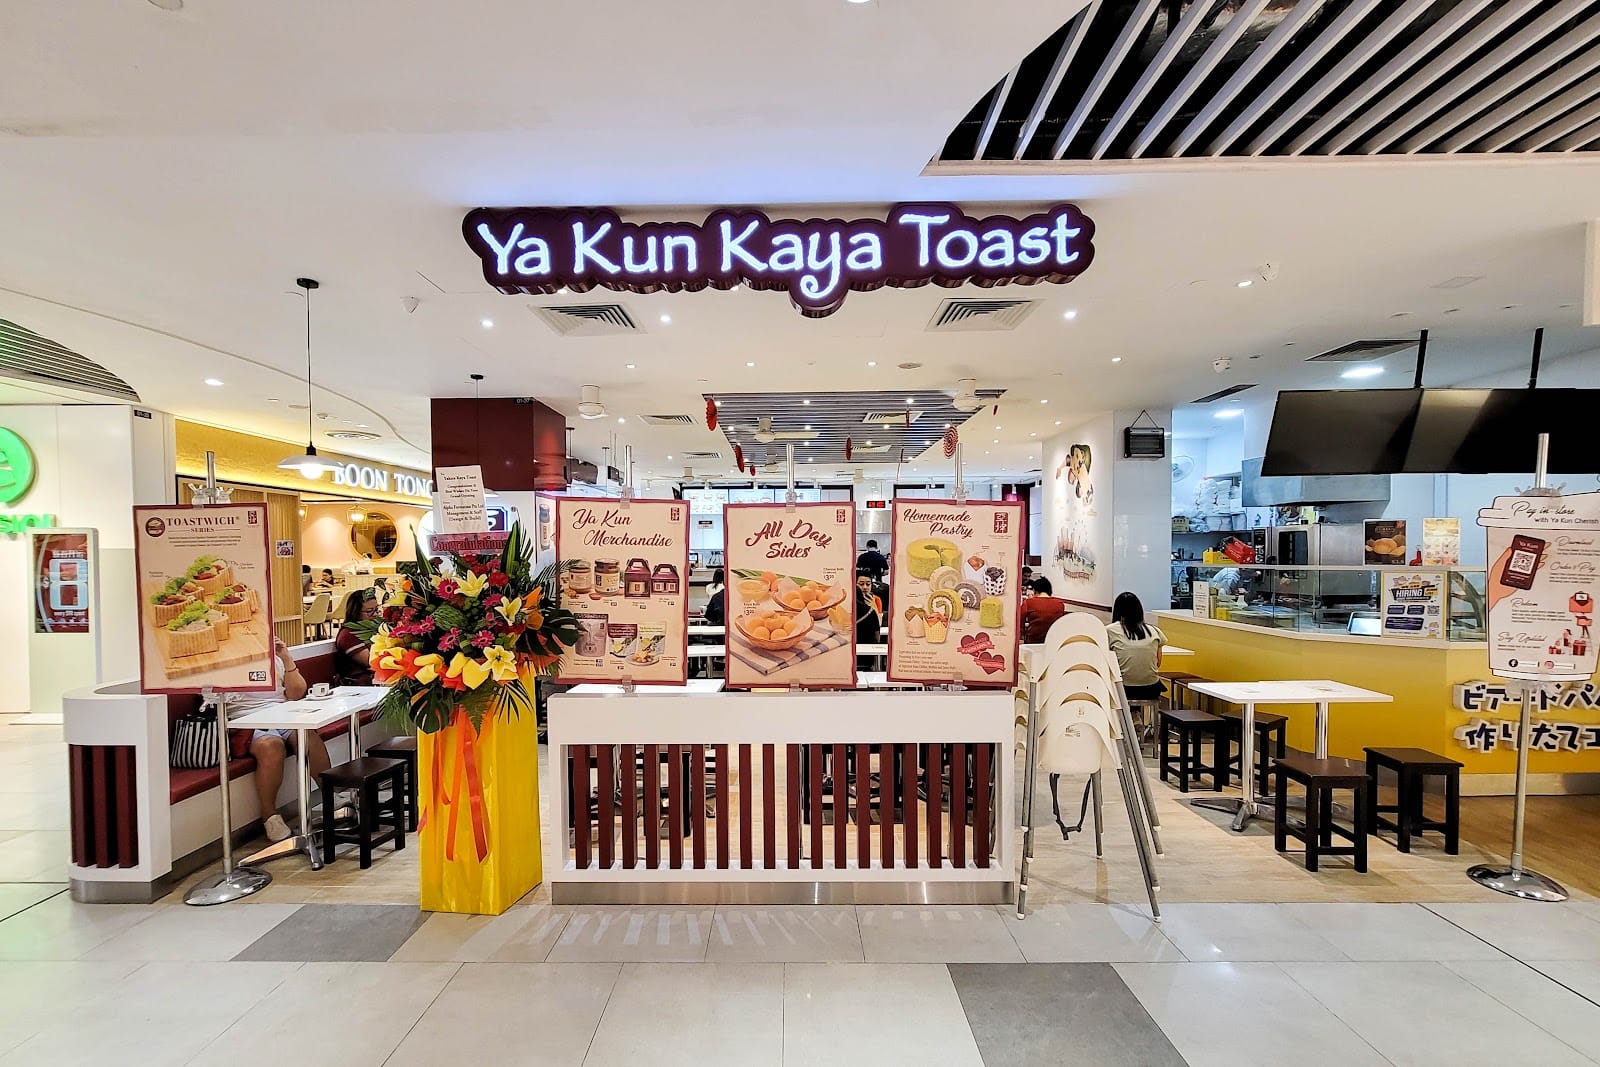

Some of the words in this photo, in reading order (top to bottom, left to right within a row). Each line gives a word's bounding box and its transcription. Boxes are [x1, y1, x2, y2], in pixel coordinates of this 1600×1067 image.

[477, 221, 550, 275] Ya
[572, 220, 698, 274] Kun
[720, 219, 882, 299] Kaya
[899, 212, 1081, 270] Toast
[334, 462, 388, 492] BOON
[903, 508, 972, 524] Homemade
[1512, 500, 1537, 518] Pay
[1539, 505, 1575, 514] in-store
[166, 516, 235, 526] TOASTWICH
[572, 508, 598, 530] Ya
[600, 509, 632, 528] Kun
[584, 530, 672, 547] Merchandise
[744, 520, 783, 547] All
[788, 519, 832, 549] Day
[929, 522, 973, 539] Pastry
[430, 536, 506, 552] Congratulations
[766, 542, 812, 558] Sides
[1396, 589, 1423, 597] HIRING
